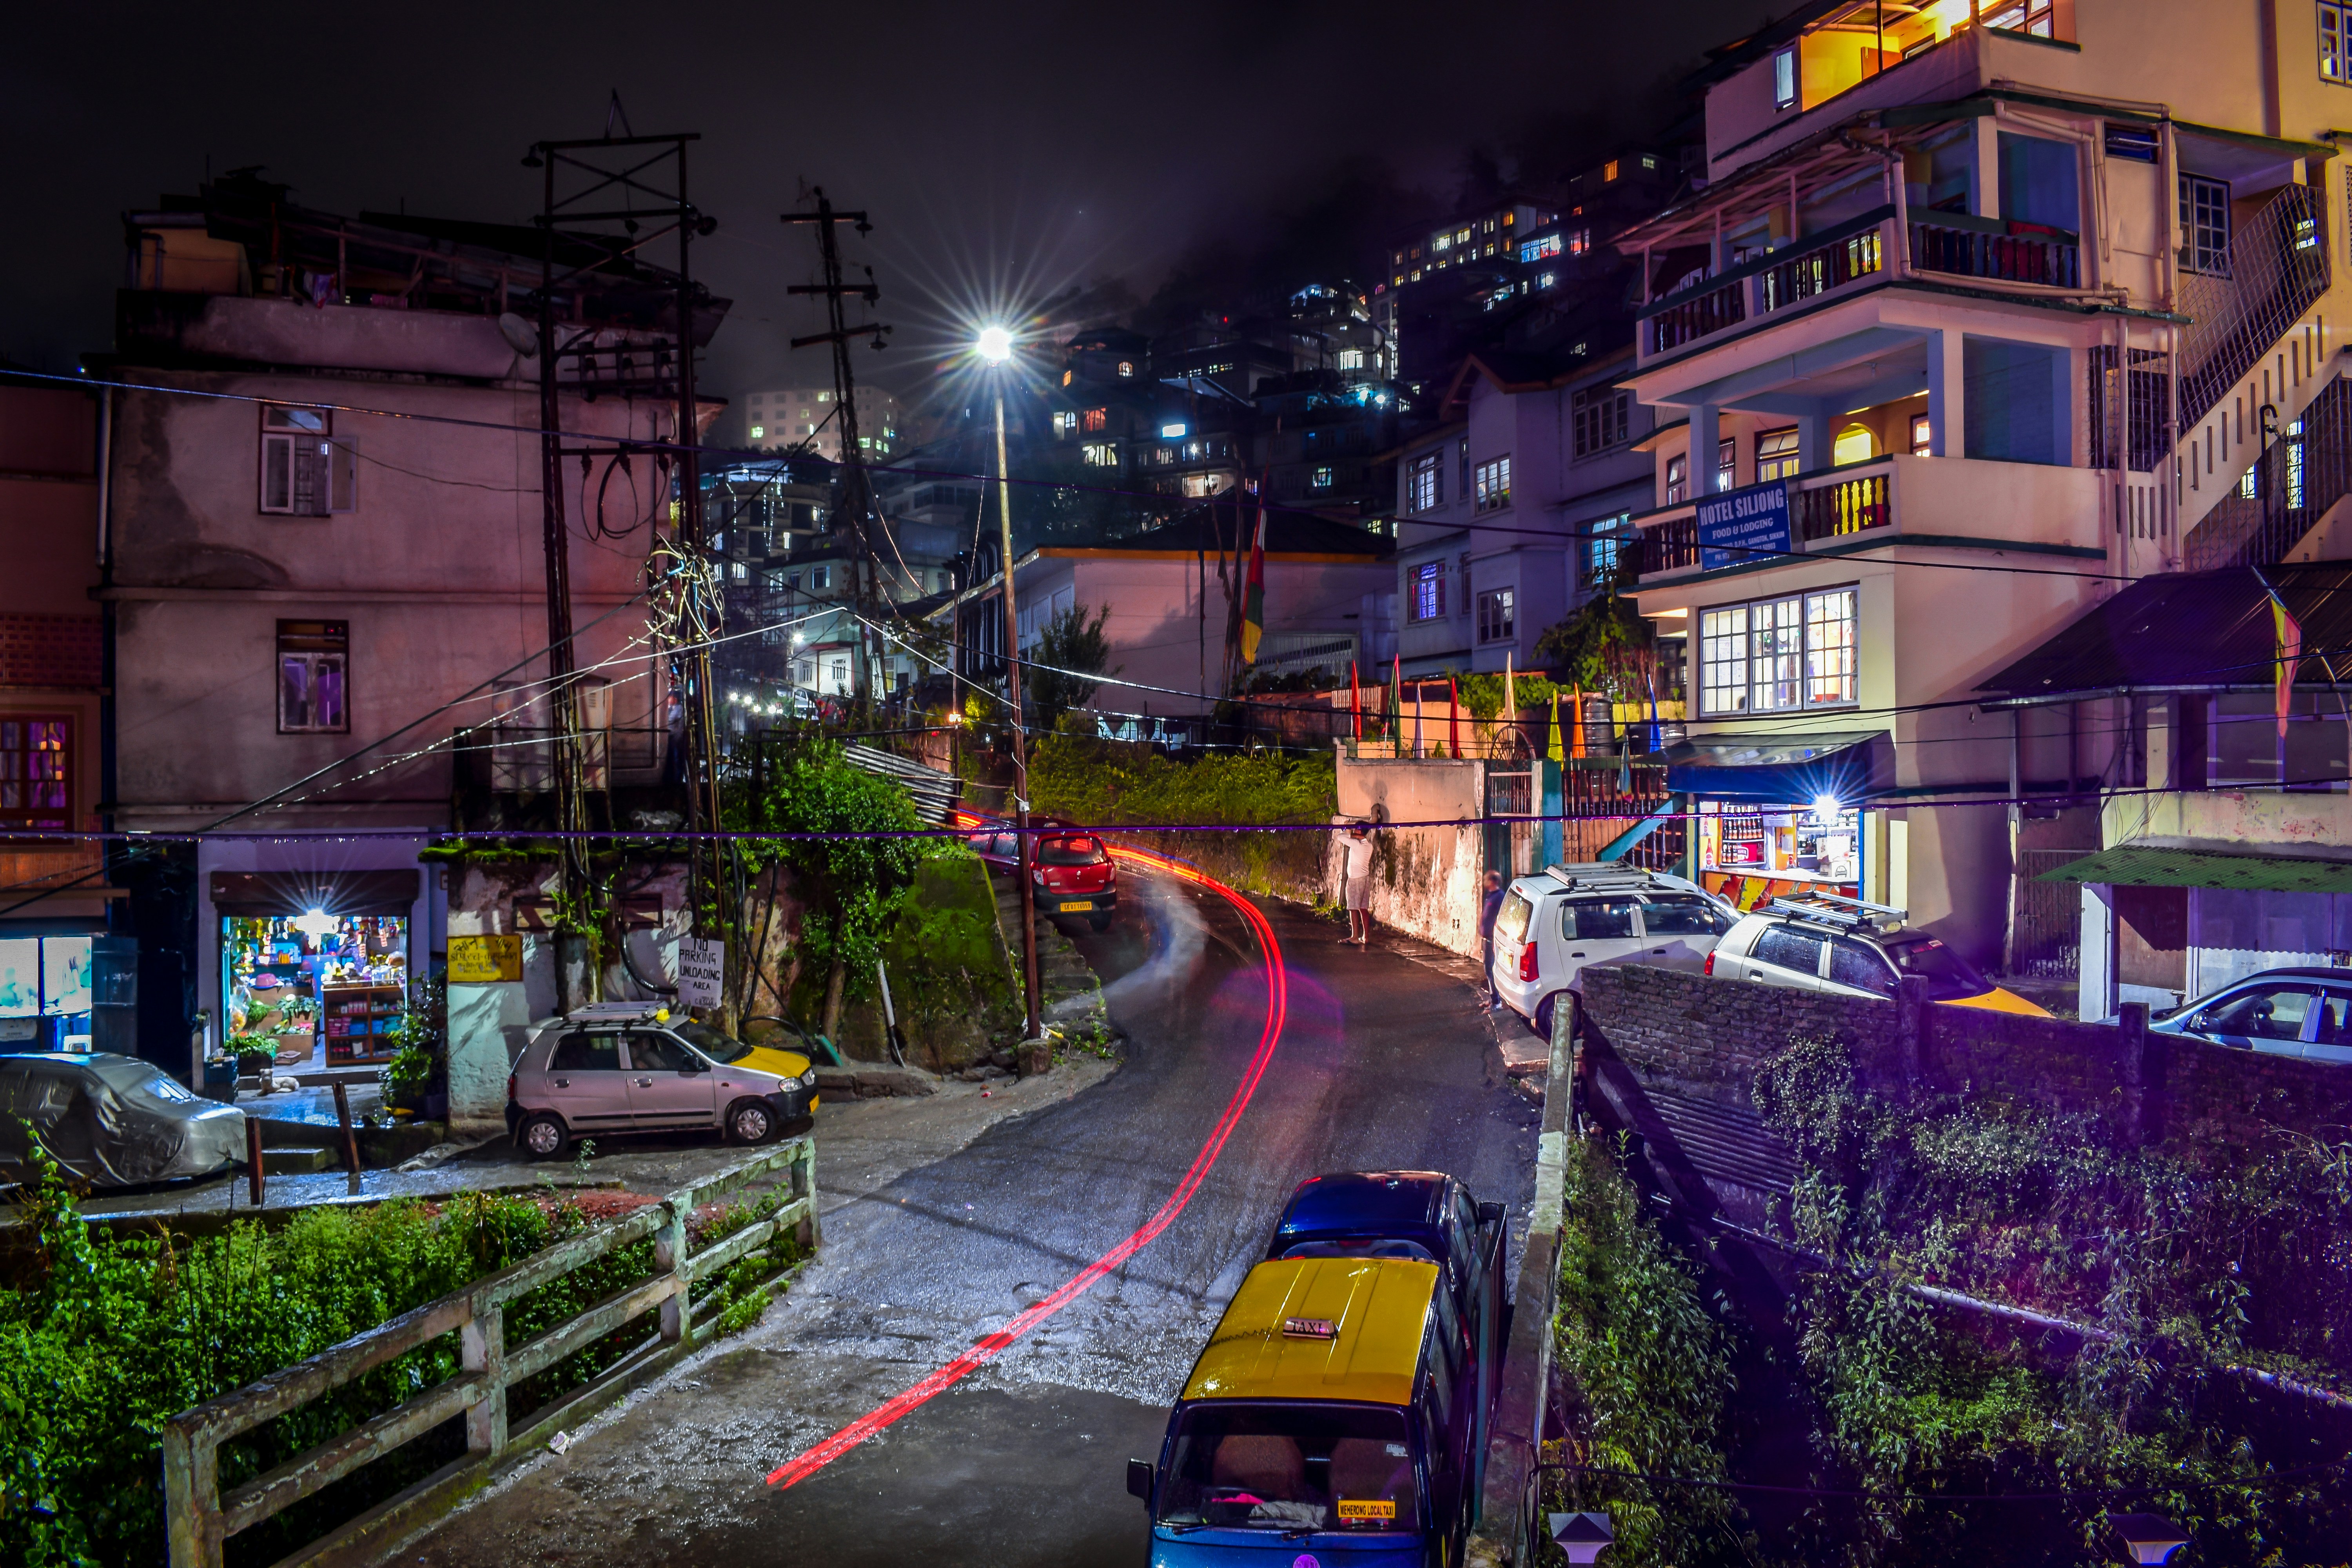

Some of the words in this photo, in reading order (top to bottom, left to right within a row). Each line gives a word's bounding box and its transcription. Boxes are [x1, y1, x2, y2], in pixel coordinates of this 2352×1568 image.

[1699, 501, 1734, 526] HOTEL
[1735, 488, 1784, 518] SILJONG
[1712, 527, 1731, 539] FOOD
[1733, 526, 1738, 534] &
[1740, 517, 1773, 533] LODGING
[693, 938, 708, 951] NO
[679, 949, 716, 965] PARKING
[693, 981, 711, 991] AREA
[1291, 1321, 1322, 1334] TAXI
[1340, 1504, 1366, 1515] MEHERONG
[1367, 1505, 1383, 1516] LOCAL
[1383, 1505, 1394, 1516] TAXI
